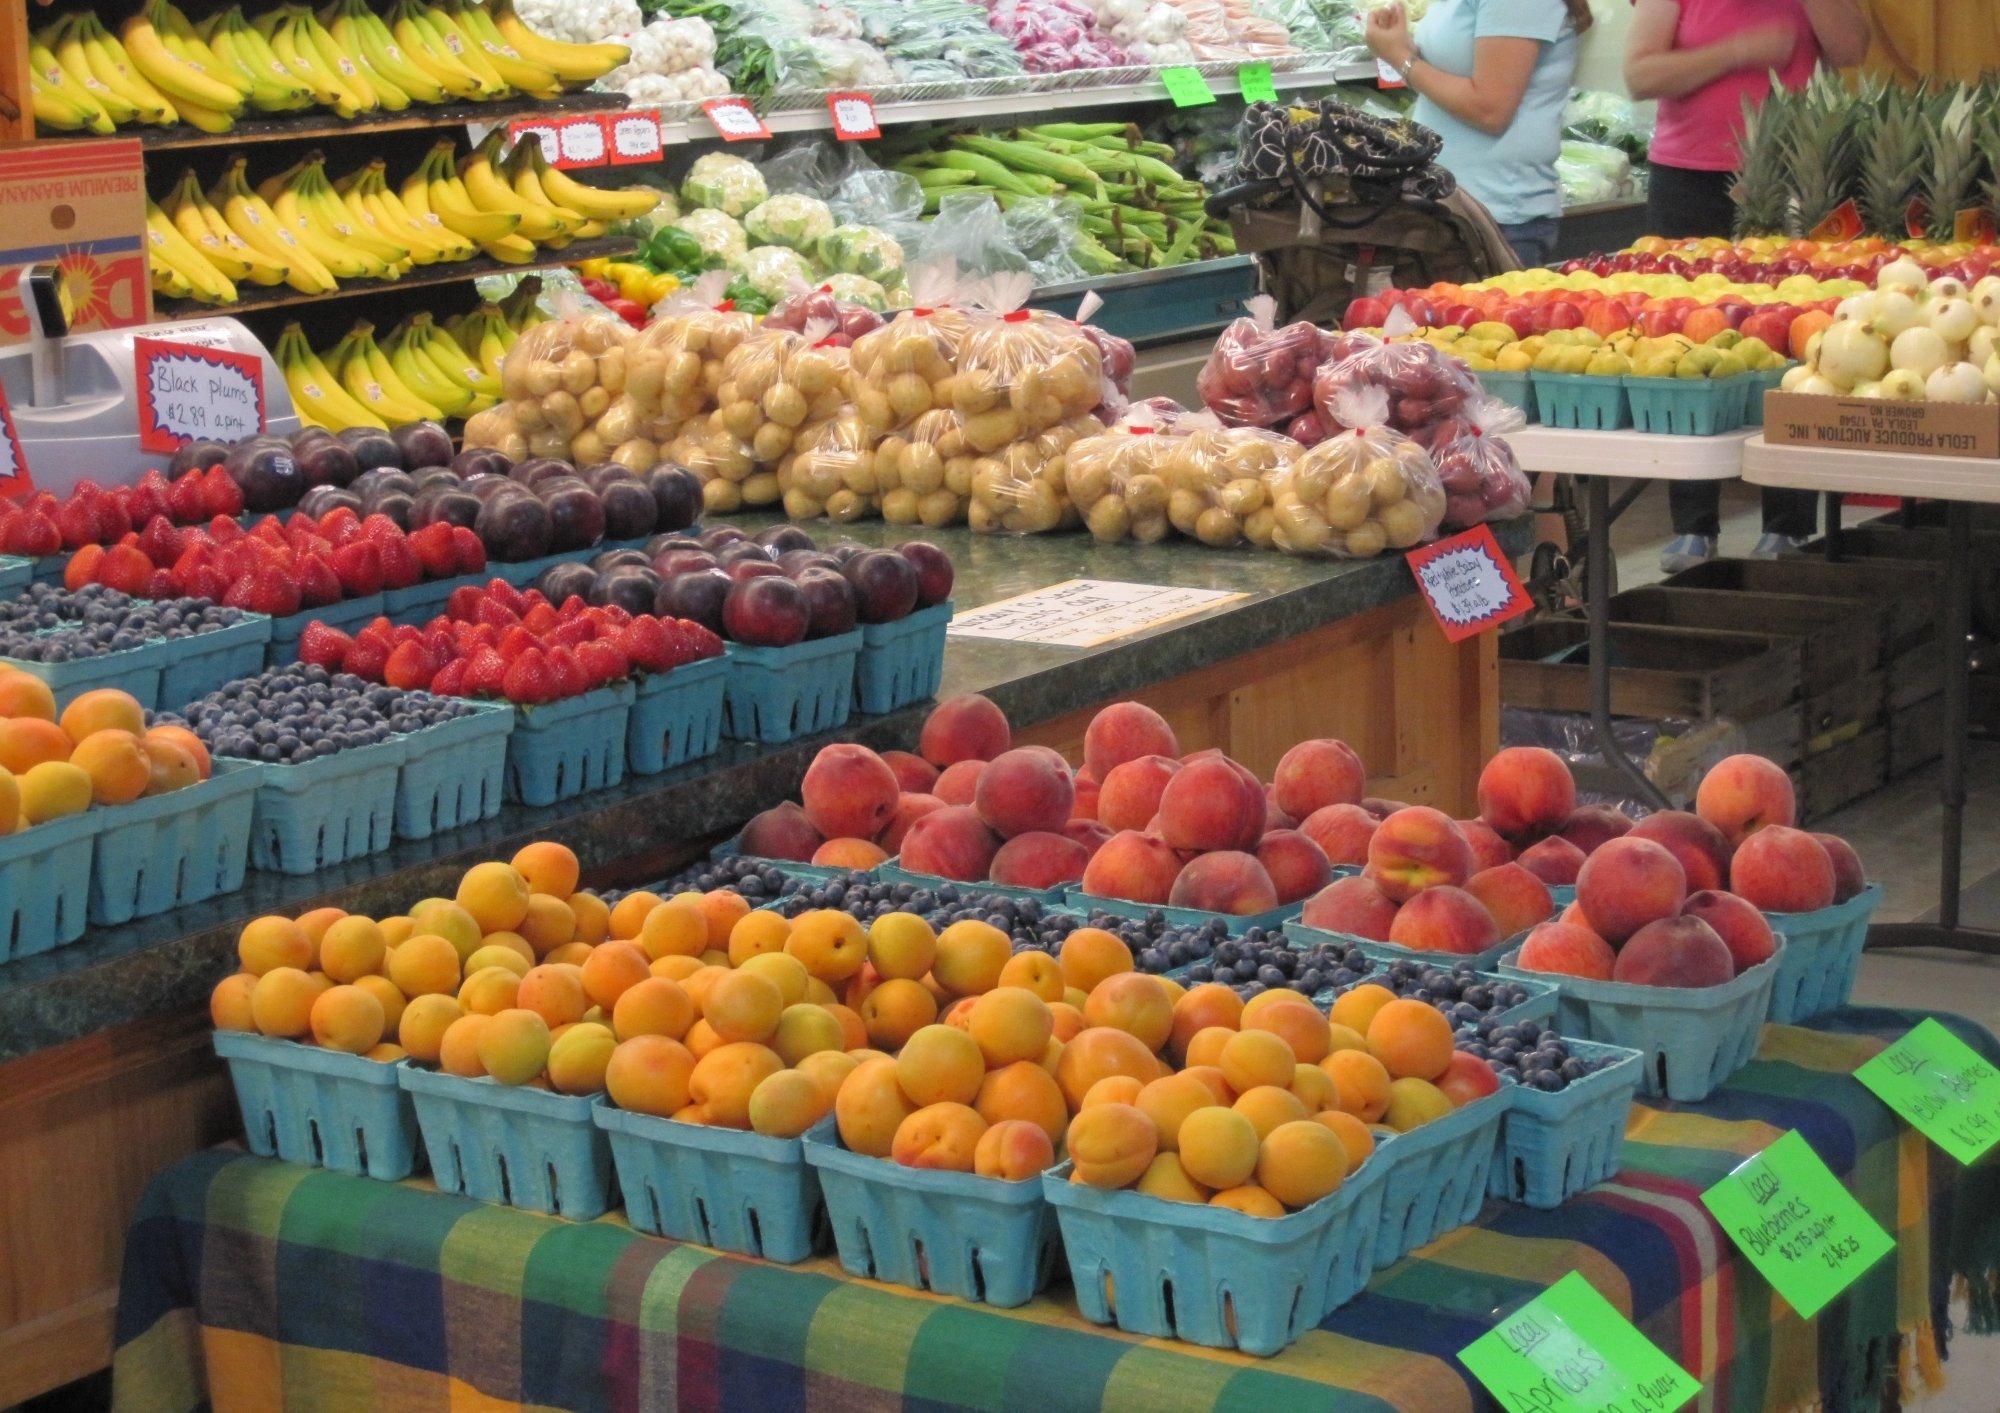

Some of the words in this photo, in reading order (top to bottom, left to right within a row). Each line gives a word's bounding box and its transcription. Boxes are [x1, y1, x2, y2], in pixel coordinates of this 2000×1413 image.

[70, 175, 138, 197] PREMIUM
[158, 365, 199, 393] Black
[209, 376, 248, 404] plums
[1885, 406, 1925, 418] GROWER
[1871, 417, 1884, 429] PA
[1813, 424, 1870, 444] AUCTION,
[1874, 430, 1933, 447] PRODUCE
[1937, 434, 1977, 449] LEOLA
[1494, 1314, 1547, 1354] Local
[1506, 1347, 1604, 1413] Apricots
